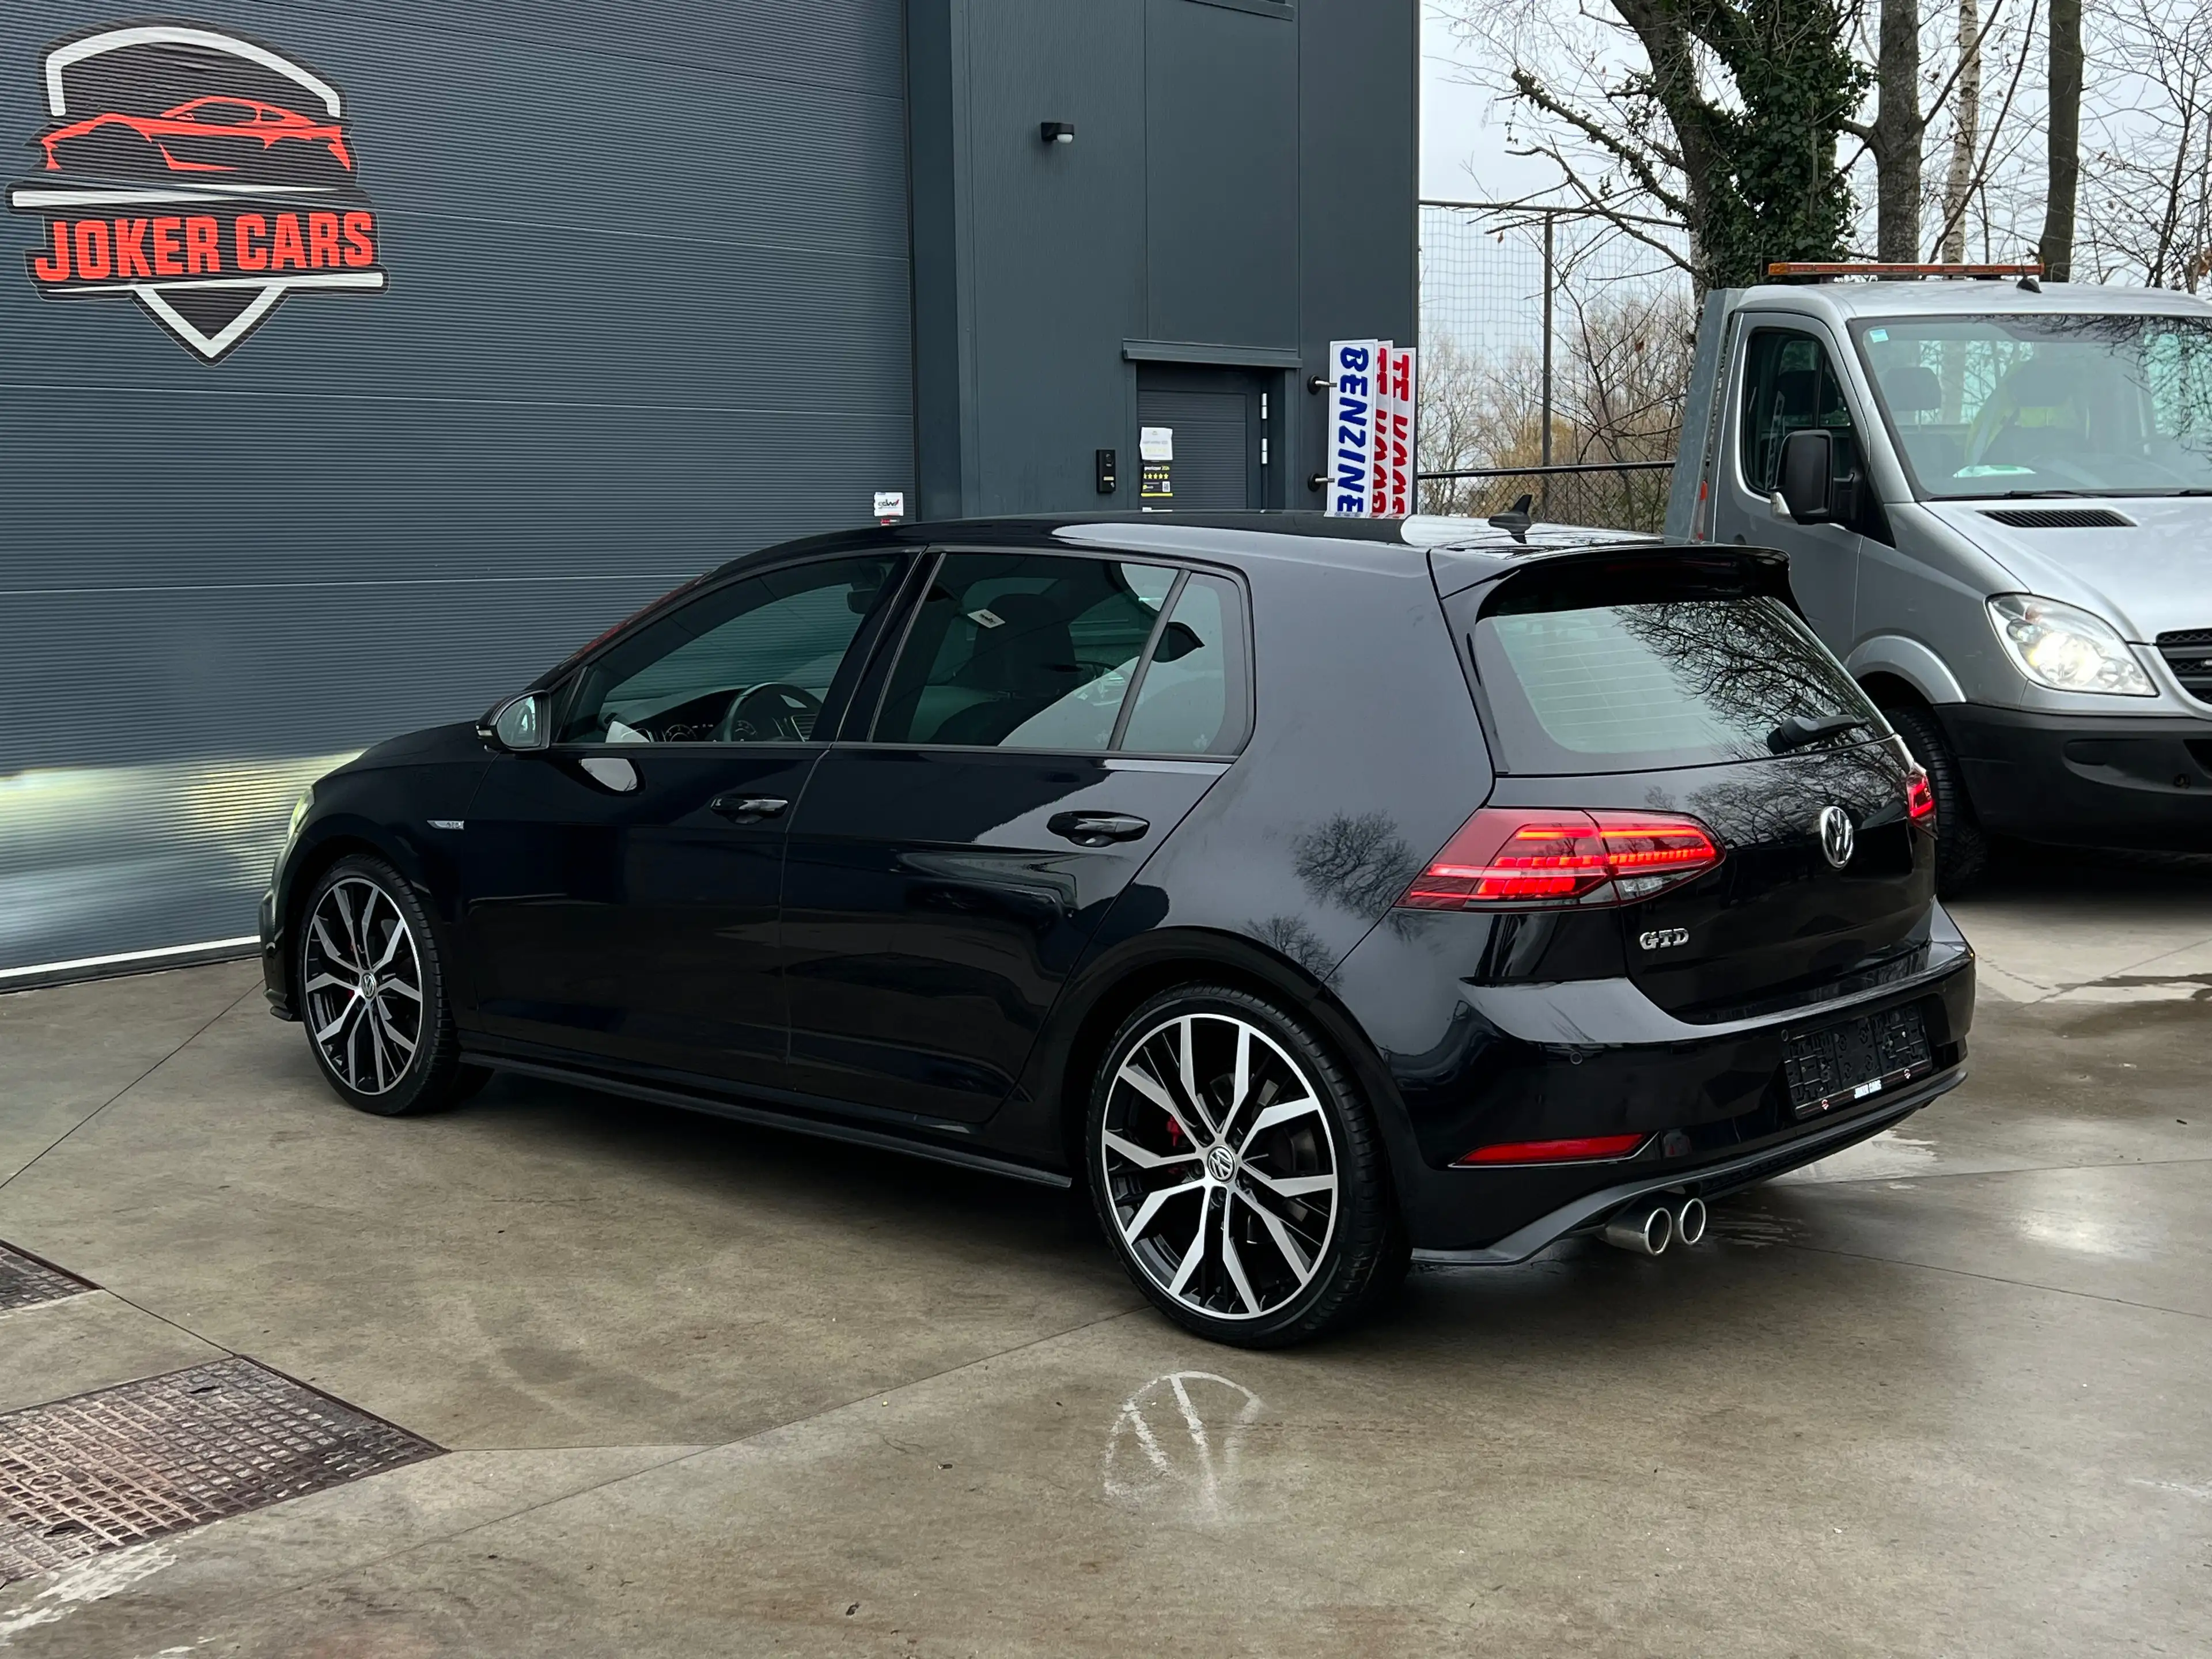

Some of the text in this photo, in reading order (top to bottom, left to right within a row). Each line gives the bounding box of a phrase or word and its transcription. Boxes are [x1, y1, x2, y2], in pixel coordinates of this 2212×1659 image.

[35, 213, 373, 281] JOKER CARS
[1339, 347, 1369, 512] BENZINE
[1640, 928, 1689, 950] GTD
